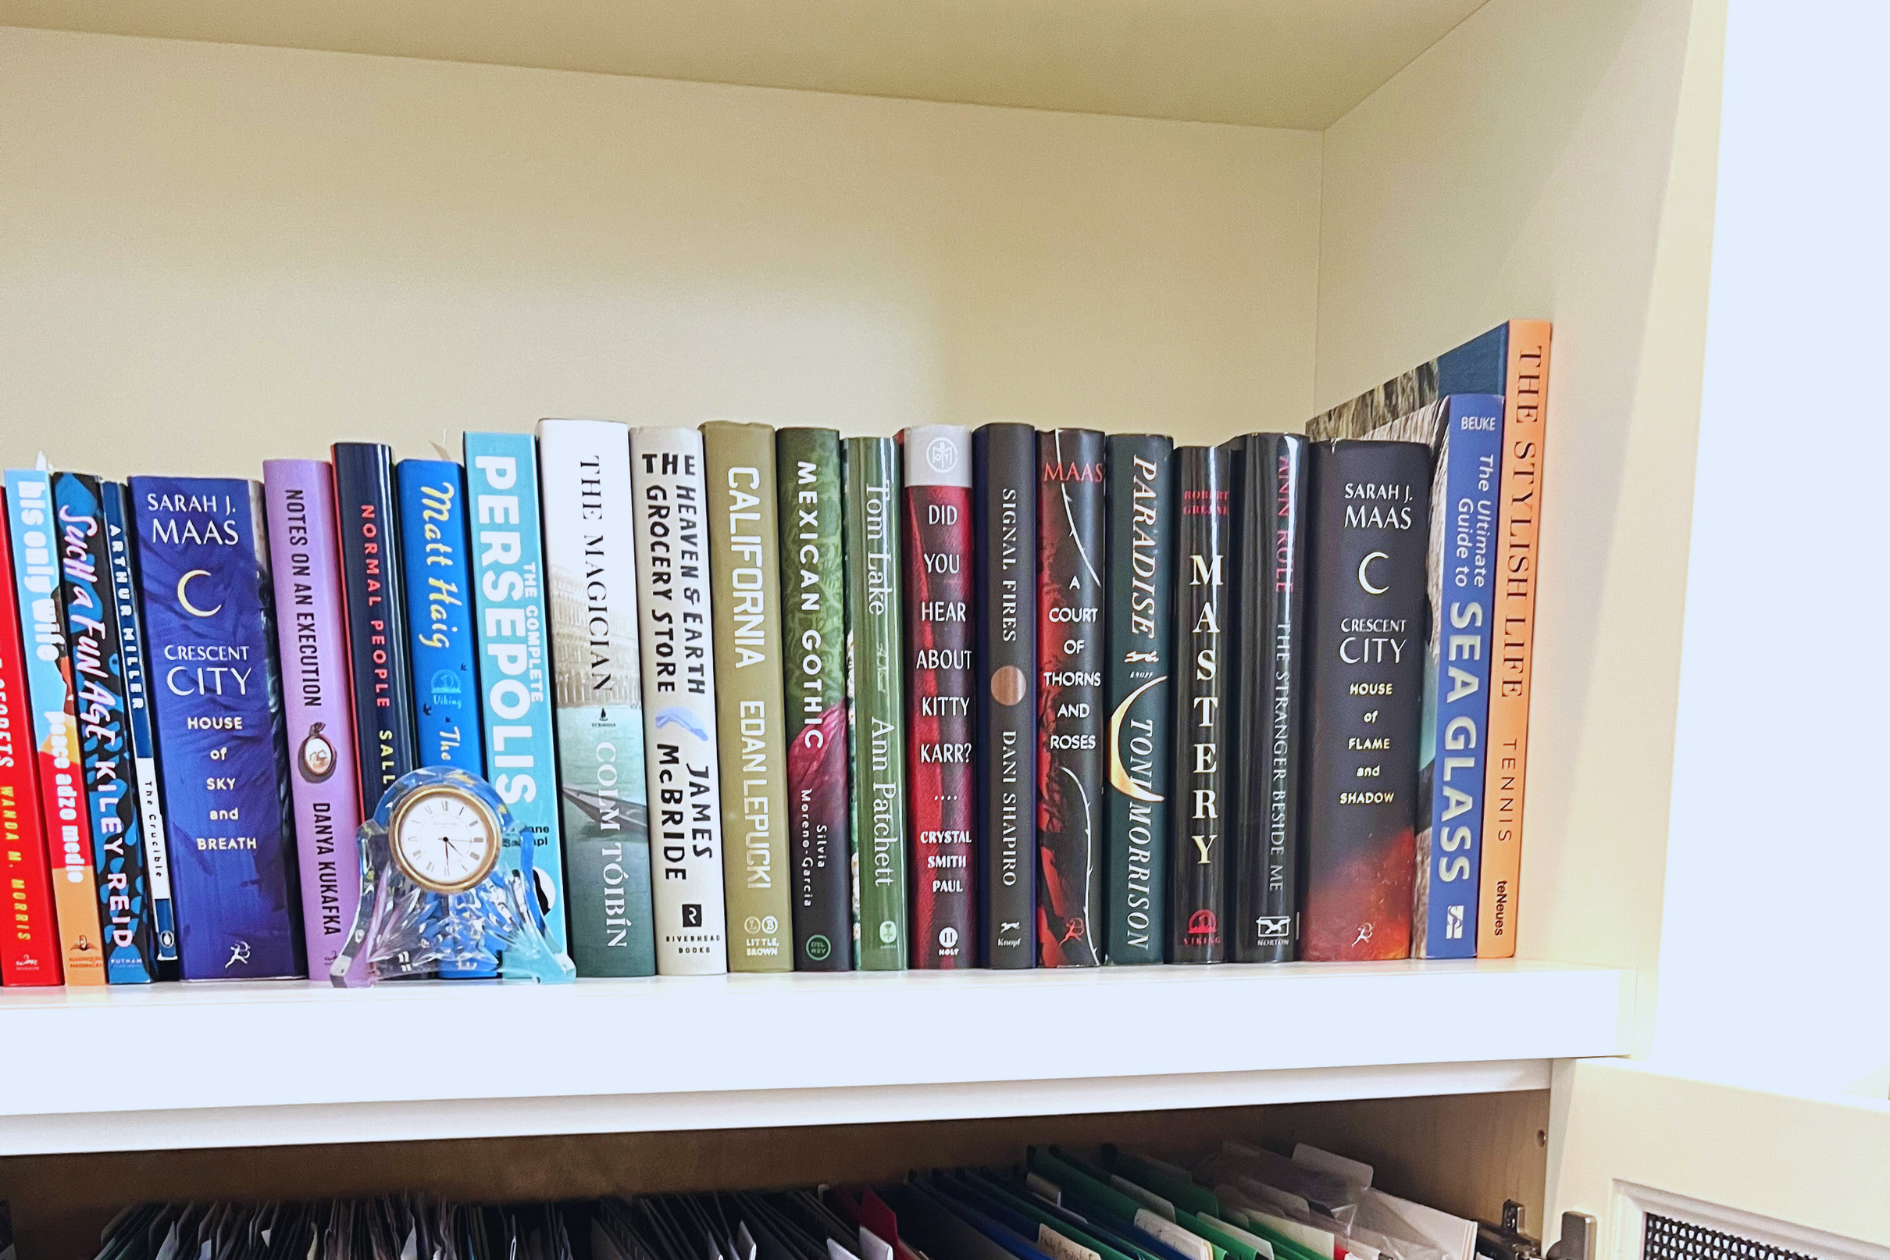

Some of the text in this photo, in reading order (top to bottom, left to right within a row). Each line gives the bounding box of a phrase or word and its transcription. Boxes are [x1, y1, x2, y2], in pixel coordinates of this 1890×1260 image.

[1461, 416, 1496, 431] BEUKE
[579, 455, 603, 520] THE
[642, 453, 695, 476] THE
[1043, 463, 1103, 484] MAAS
[148, 494, 236, 515] SARAH J.
[866, 482, 890, 540] Tom
[928, 504, 958, 525] DID
[1344, 483, 1413, 503] SARAH J.
[1344, 505, 1412, 530] MAAS
[152, 520, 239, 545] MAAS
[1130, 455, 1157, 638] PARADISE
[1455, 498, 1474, 587] Guide to
[1473, 455, 1494, 587] The Ultimate
[1502, 345, 1542, 698] THE STYLISH LIFE
[17, 481, 66, 661] his only wife
[418, 481, 462, 649] Matt Haig
[728, 466, 766, 669] CALIFORNIA
[867, 553, 892, 616] Lake
[923, 553, 960, 574] YOU
[1002, 488, 1017, 642] SIGNAL FIRES
[1069, 575, 1080, 590] A
[1275, 529, 1294, 593] RULE
[71, 586, 93, 609] a
[286, 489, 321, 707] NOTES ON AN EXECUTION
[361, 505, 390, 708] NORMAL PEOPLE
[584, 534, 613, 692] MAGICIAN
[646, 484, 677, 693] GROCERY STORE
[676, 484, 705, 695] HEAVEN & EARTH
[797, 461, 824, 749] MEXICAN GOTHIC
[921, 601, 967, 622] HEAR
[109, 524, 144, 710] ARTHUR MILLER
[475, 455, 537, 806] PERSEPOLIS
[523, 562, 543, 703] THE COMPLETE
[1049, 608, 1098, 623] COURT
[1340, 618, 1407, 633] CRESCENT
[164, 645, 249, 661] CRESCENT
[916, 649, 972, 670] ABOUT
[1063, 639, 1085, 654] OF
[1339, 637, 1407, 665] CITY
[166, 666, 251, 696] CITY
[433, 695, 462, 709] Viking
[1043, 672, 1101, 687] THORNS
[1349, 683, 1393, 695] HOUSE
[79, 681, 116, 746] AGE
[188, 717, 243, 730] HOUSE
[922, 696, 969, 717] KITTY
[1057, 704, 1090, 718] AND
[1189, 554, 1224, 865] MASTERY
[1364, 710, 1378, 723] of
[210, 747, 227, 760] of
[379, 729, 396, 786] SALL
[439, 725, 461, 762] The
[871, 716, 896, 771] Ann
[920, 742, 972, 764] KARR?
[1050, 735, 1096, 749] ROSES
[1269, 623, 1291, 891] THE STRANGER BESIDE ME
[1348, 738, 1390, 750] FLAME
[1439, 601, 1482, 882] SEA GLASS
[44, 711, 85, 883] peace adzo medie
[207, 778, 235, 790] SKY
[595, 741, 621, 831] COLM
[740, 700, 772, 889] EDAN LEPUCKI
[1356, 765, 1380, 777] and
[1498, 738, 1517, 842] TENNIS
[0, 786, 19, 841] WANDA
[95, 761, 124, 856] KILEY
[210, 807, 238, 820] and
[656, 743, 687, 881] McBRIDE
[686, 762, 713, 860] JAMES
[1002, 731, 1017, 886] DANI SHAPIRO
[1340, 792, 1395, 804] SHADOW
[145, 781, 161, 878] The Crucible
[197, 838, 257, 850] BREATH
[313, 803, 335, 855] DANYA
[801, 788, 815, 907] Moreno-Garcia
[816, 824, 828, 869] Silvia
[872, 781, 898, 887] Patchett
[920, 831, 972, 844] CRYSTAL
[8, 850, 22, 868] M.
[927, 855, 967, 868] SMITH
[1127, 801, 1152, 950] MORRISON
[11, 879, 30, 940] MORRIS
[107, 873, 133, 948] REID
[319, 861, 341, 936] KUKAFKA
[601, 842, 632, 948] TÓIBÍN
[932, 880, 963, 893] PAUL
[1494, 880, 1508, 936] teNeues
[665, 934, 721, 942] RIVERHEAD
[678, 946, 711, 954] BOOKS
[746, 947, 778, 956] BROWN
